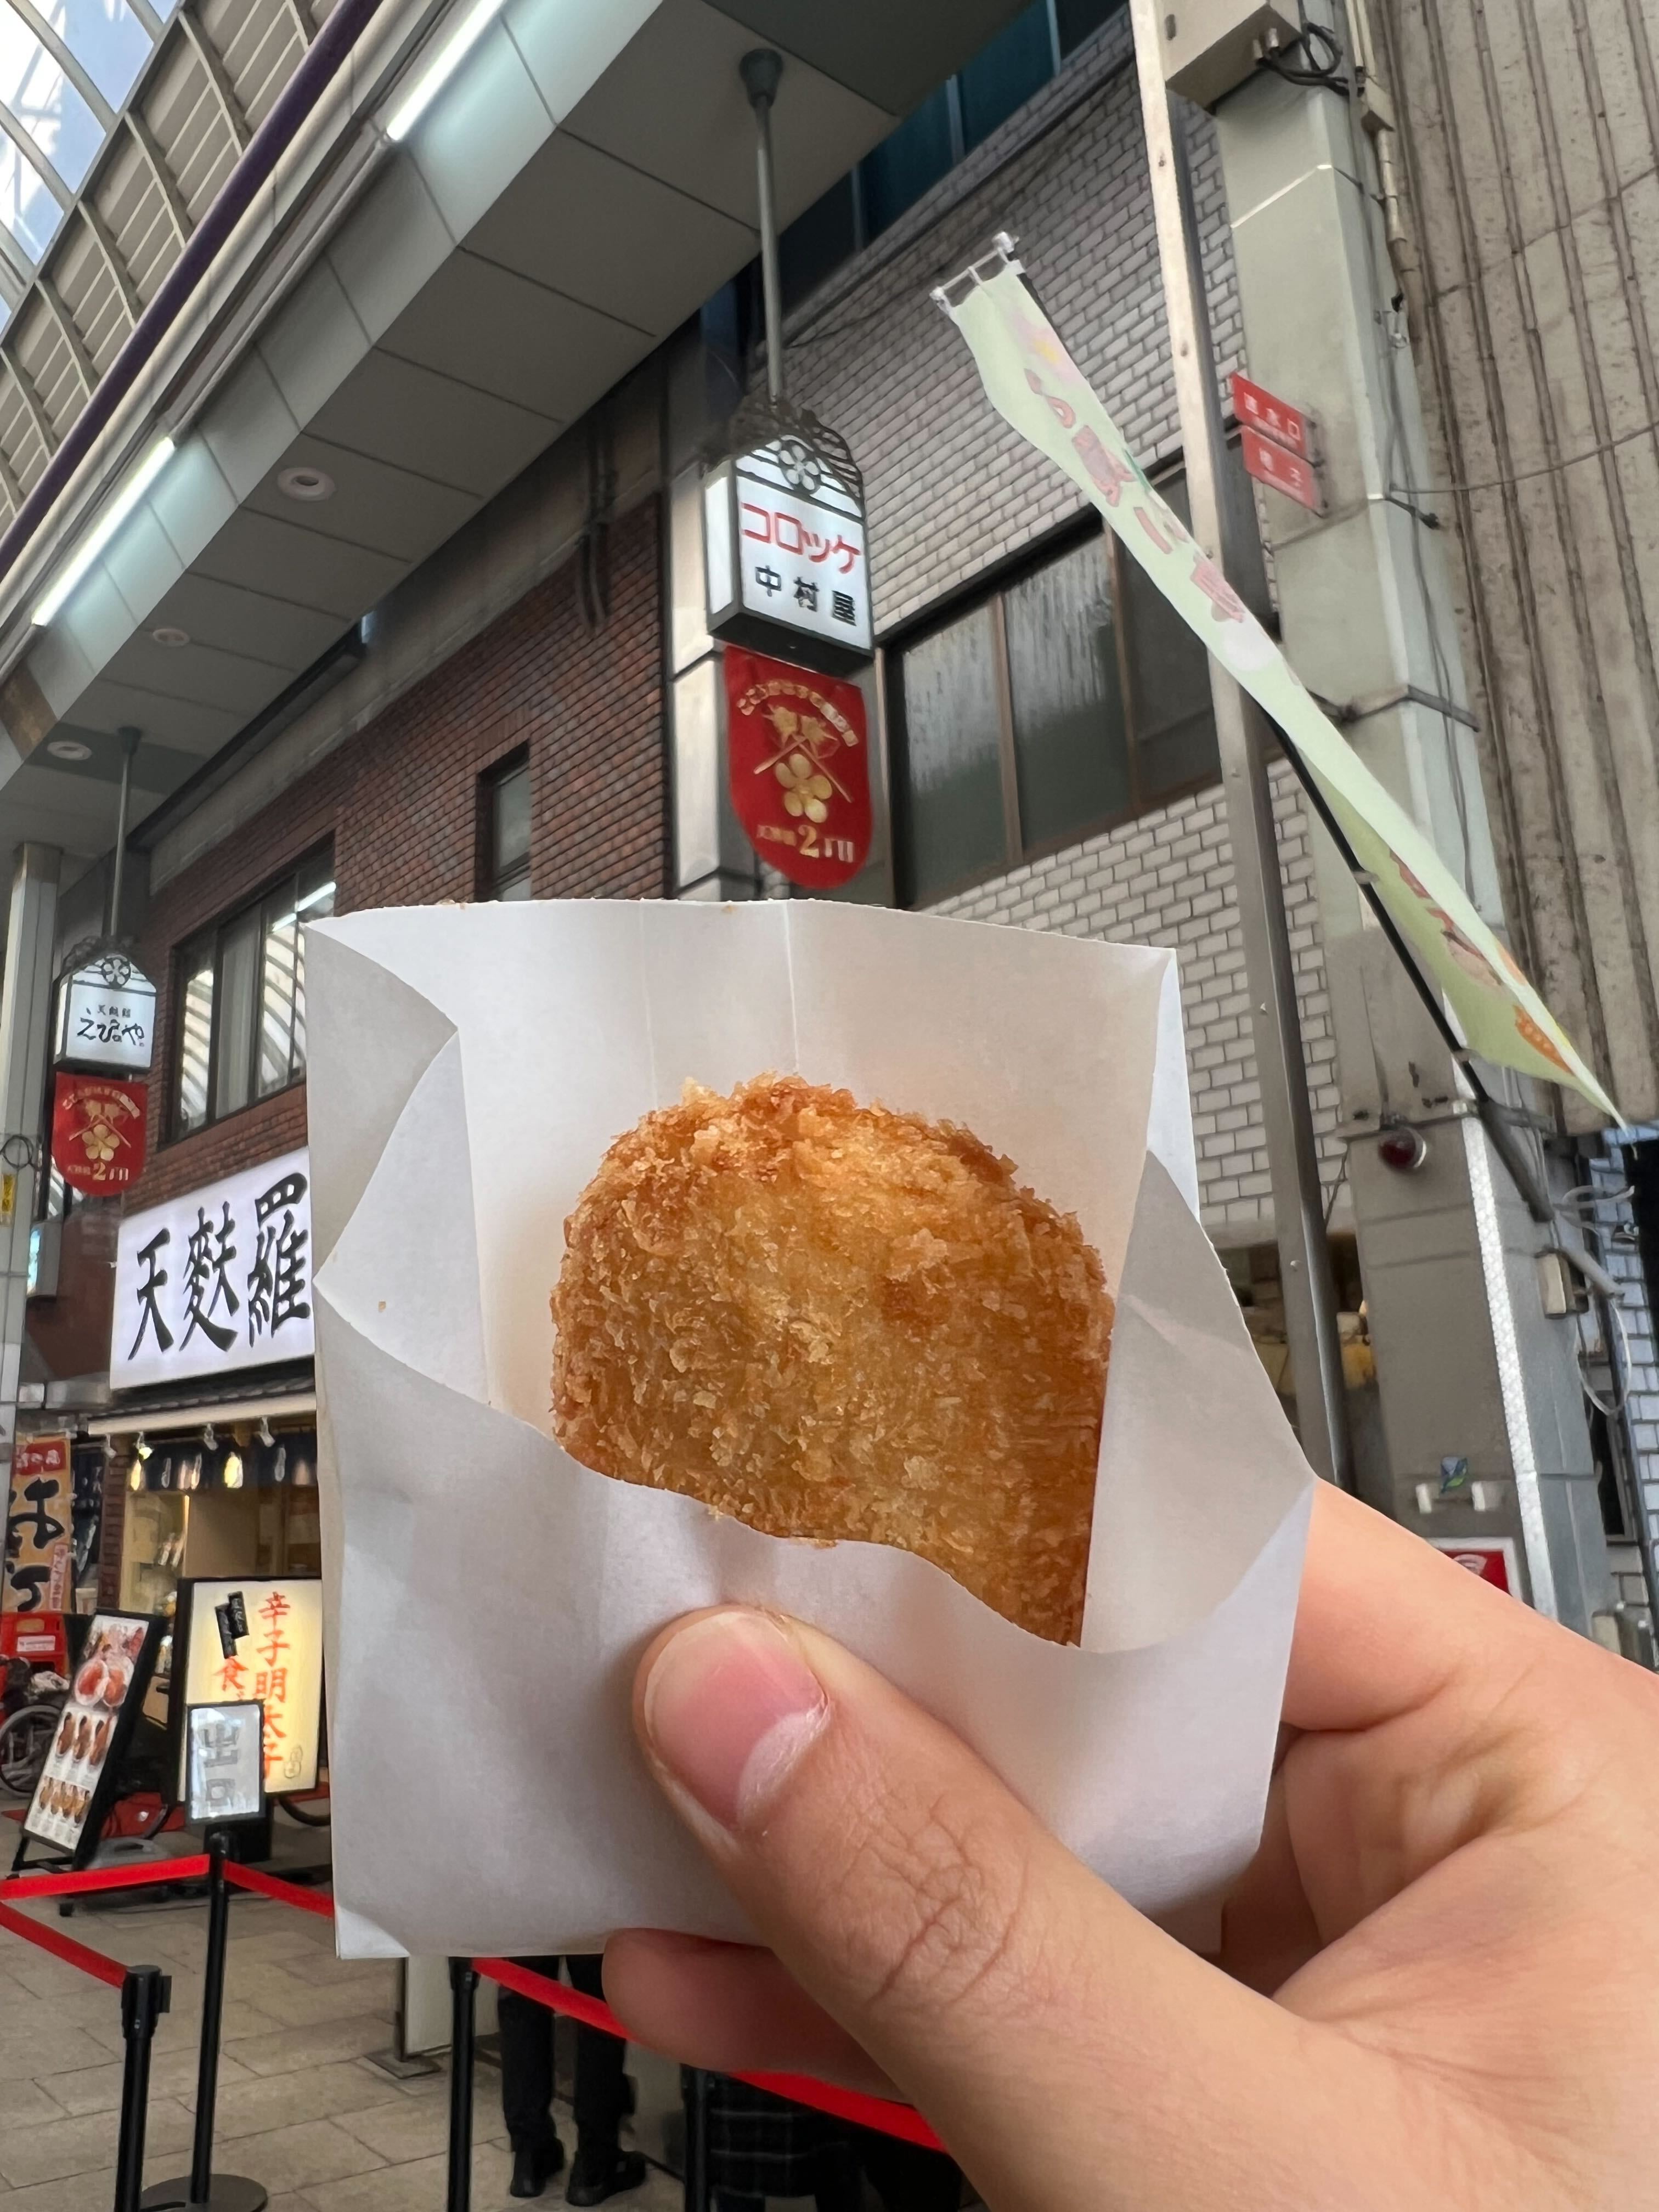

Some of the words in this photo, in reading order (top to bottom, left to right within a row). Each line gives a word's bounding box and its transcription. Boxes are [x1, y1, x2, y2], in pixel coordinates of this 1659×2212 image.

[741, 502, 861, 574] コロッケ
[755, 565, 857, 627] 中村屋
[128, 1172, 311, 1361] 天麩羅
